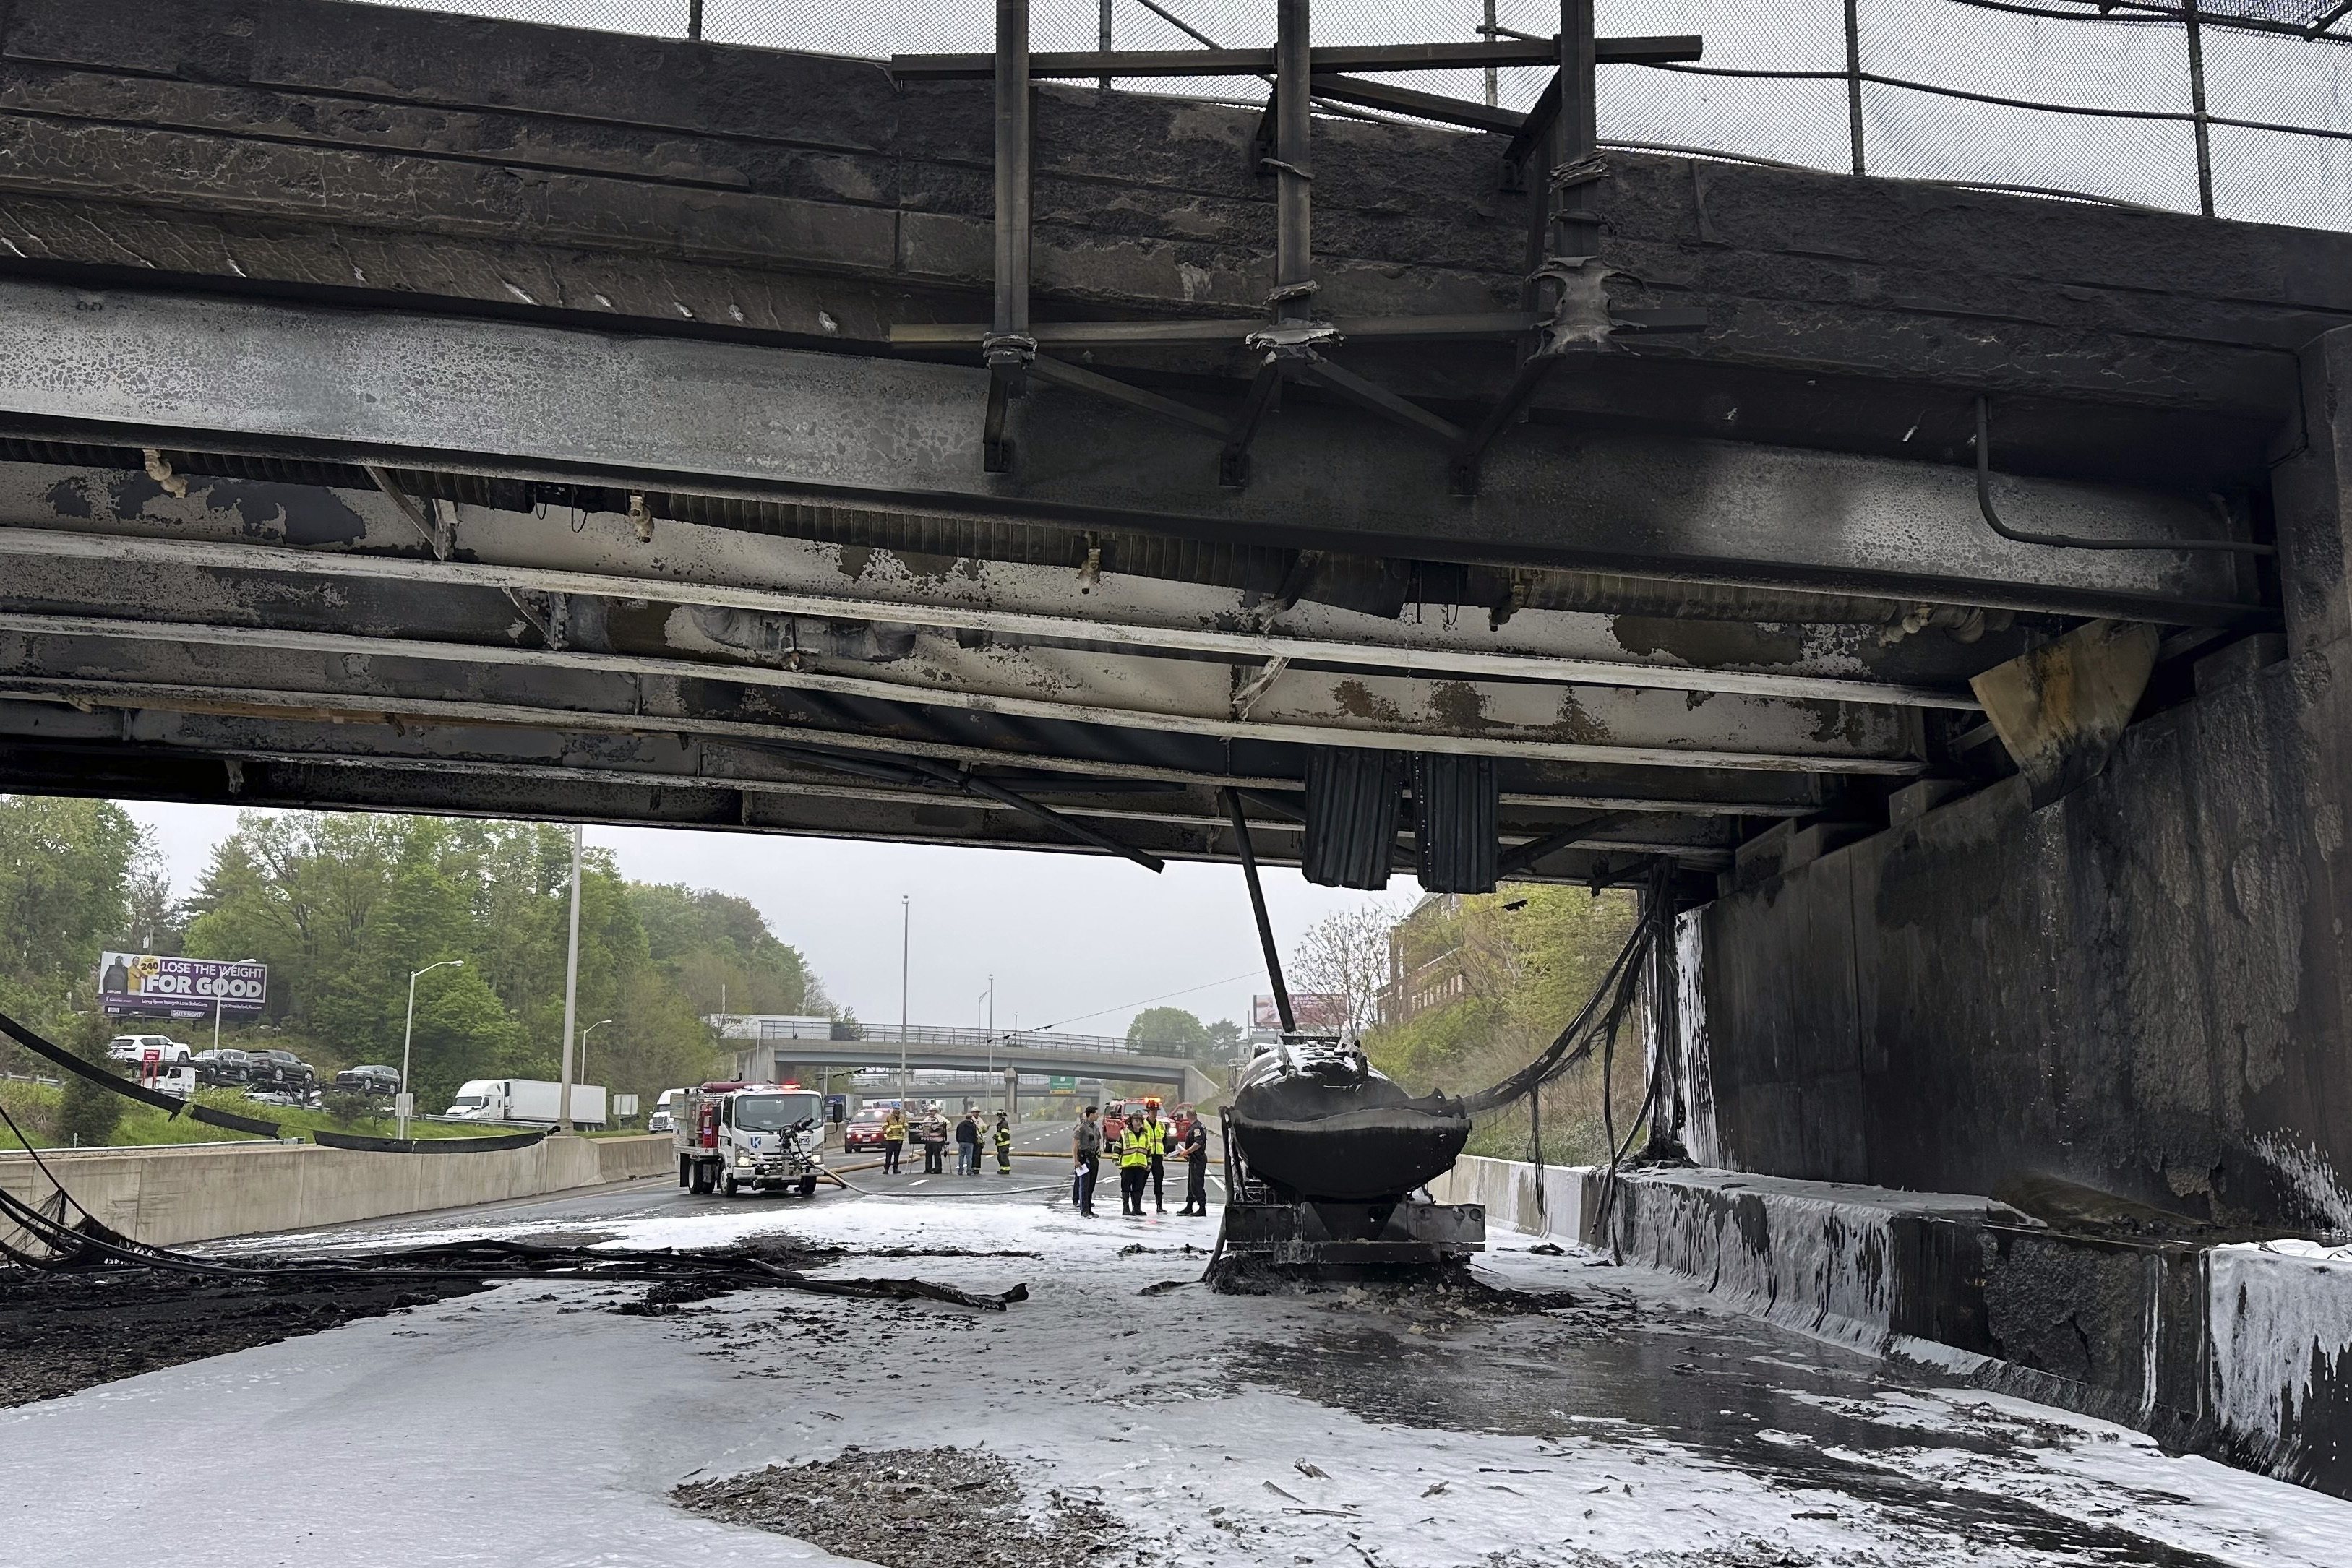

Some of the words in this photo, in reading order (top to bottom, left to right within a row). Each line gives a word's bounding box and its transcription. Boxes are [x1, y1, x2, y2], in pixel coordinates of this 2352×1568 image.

[140, 962, 159, 970] 240
[161, 961, 192, 973] LOSE
[194, 963, 216, 975] THE
[218, 965, 264, 978] WEIGHT
[146, 974, 192, 994] FOR
[196, 976, 262, 997] GOOD
